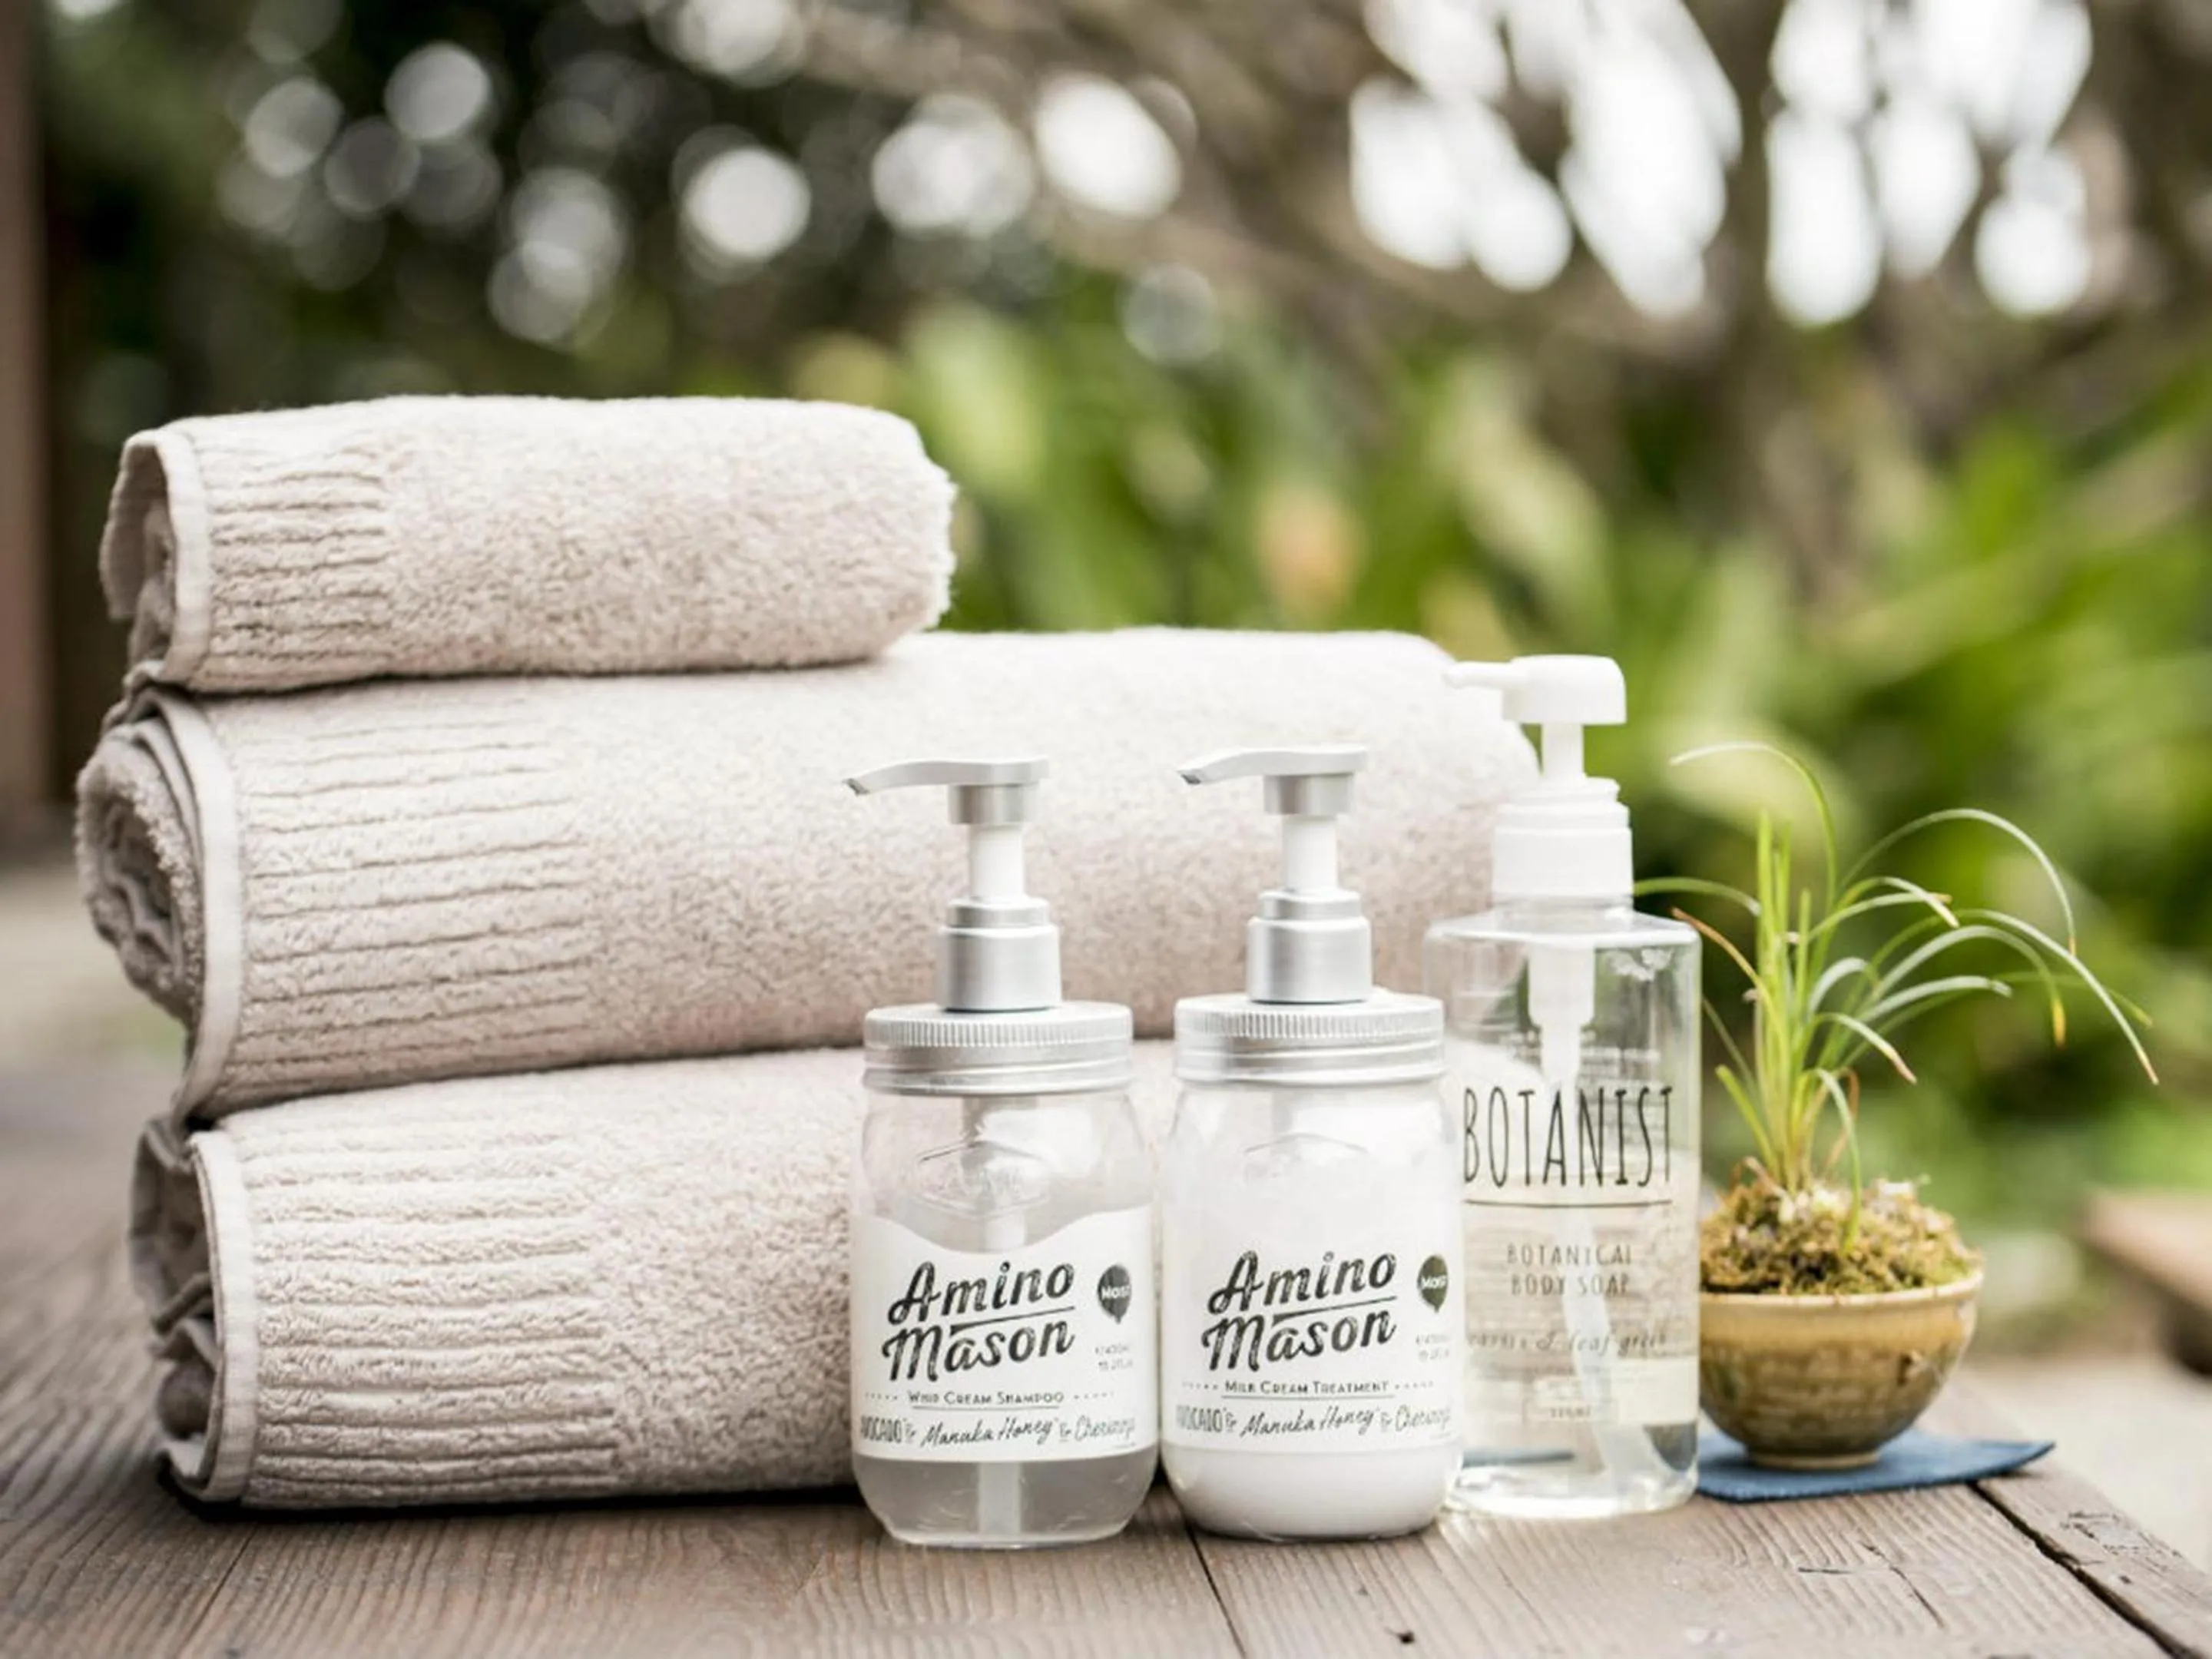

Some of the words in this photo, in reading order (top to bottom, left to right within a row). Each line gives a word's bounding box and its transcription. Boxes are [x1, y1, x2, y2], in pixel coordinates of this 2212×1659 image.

[1464, 1087, 1673, 1187] BOTANIST
[1207, 1250, 1396, 1314] Amino
[1507, 1243, 1631, 1266] BOTANICAL
[1511, 1273, 1566, 1296] BODY
[1578, 1274, 1629, 1296] SOAP
[887, 1261, 1074, 1325] Amino
[882, 1320, 1075, 1382] Mason
[1201, 1310, 1396, 1372] Mason
[998, 1416, 1053, 1445] Honey
